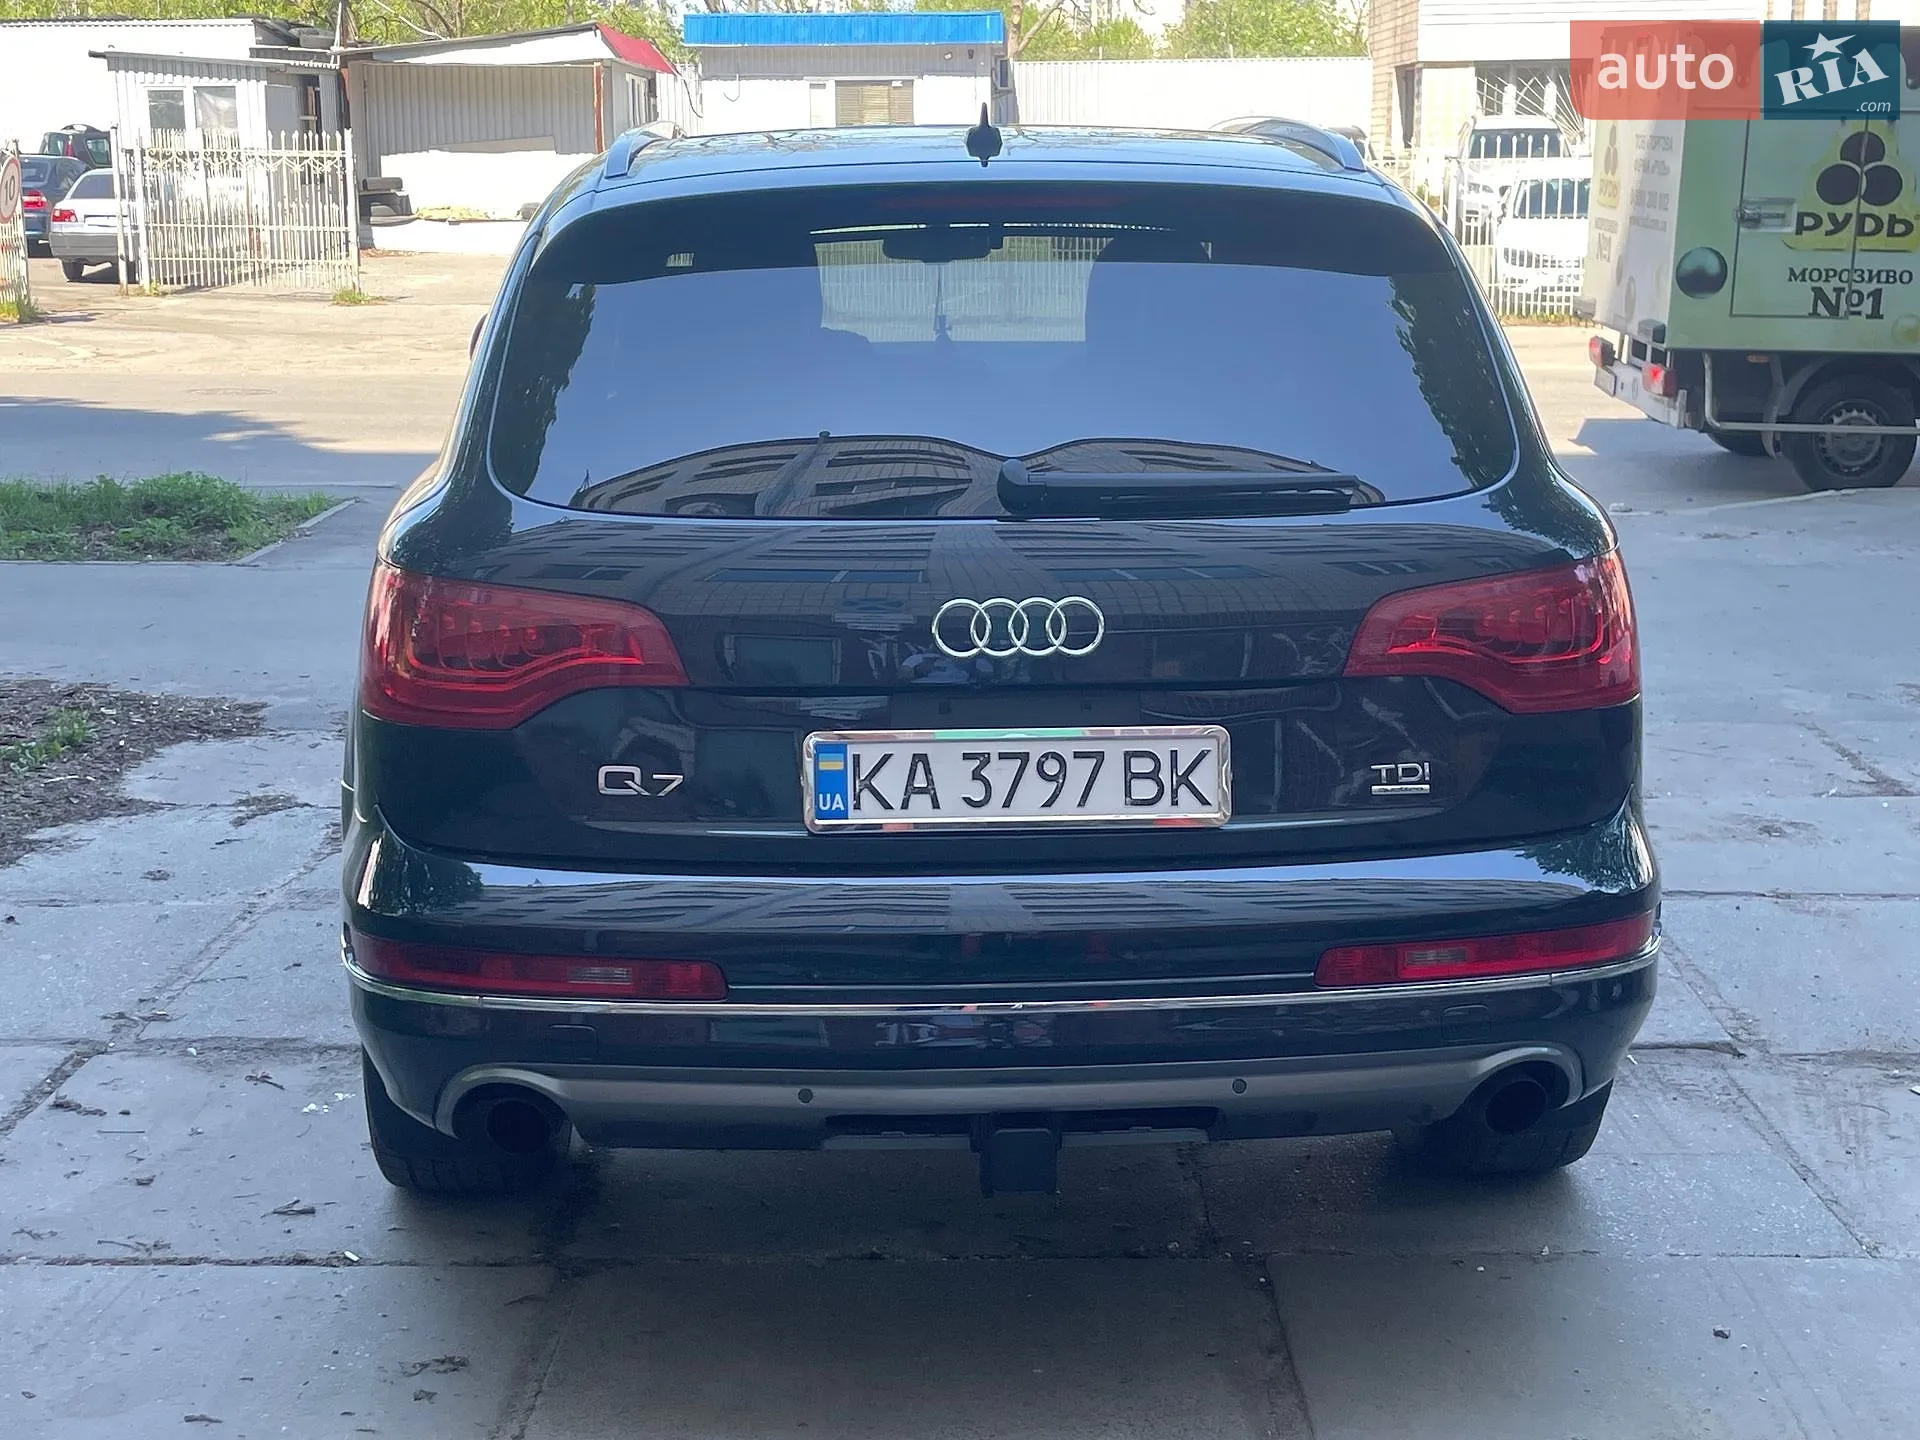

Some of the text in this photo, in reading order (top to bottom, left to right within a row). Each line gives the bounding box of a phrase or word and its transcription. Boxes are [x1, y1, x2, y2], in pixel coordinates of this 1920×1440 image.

[5, 175, 15, 205] 10
[1795, 211, 1914, 238] РУДЬ
[1788, 267, 1914, 285] МОРОЗИВО
[598, 765, 684, 797] Q7
[852, 749, 1212, 811] KA 3797 BK
[1371, 762, 1430, 784] TDI
[818, 793, 845, 811] UA
